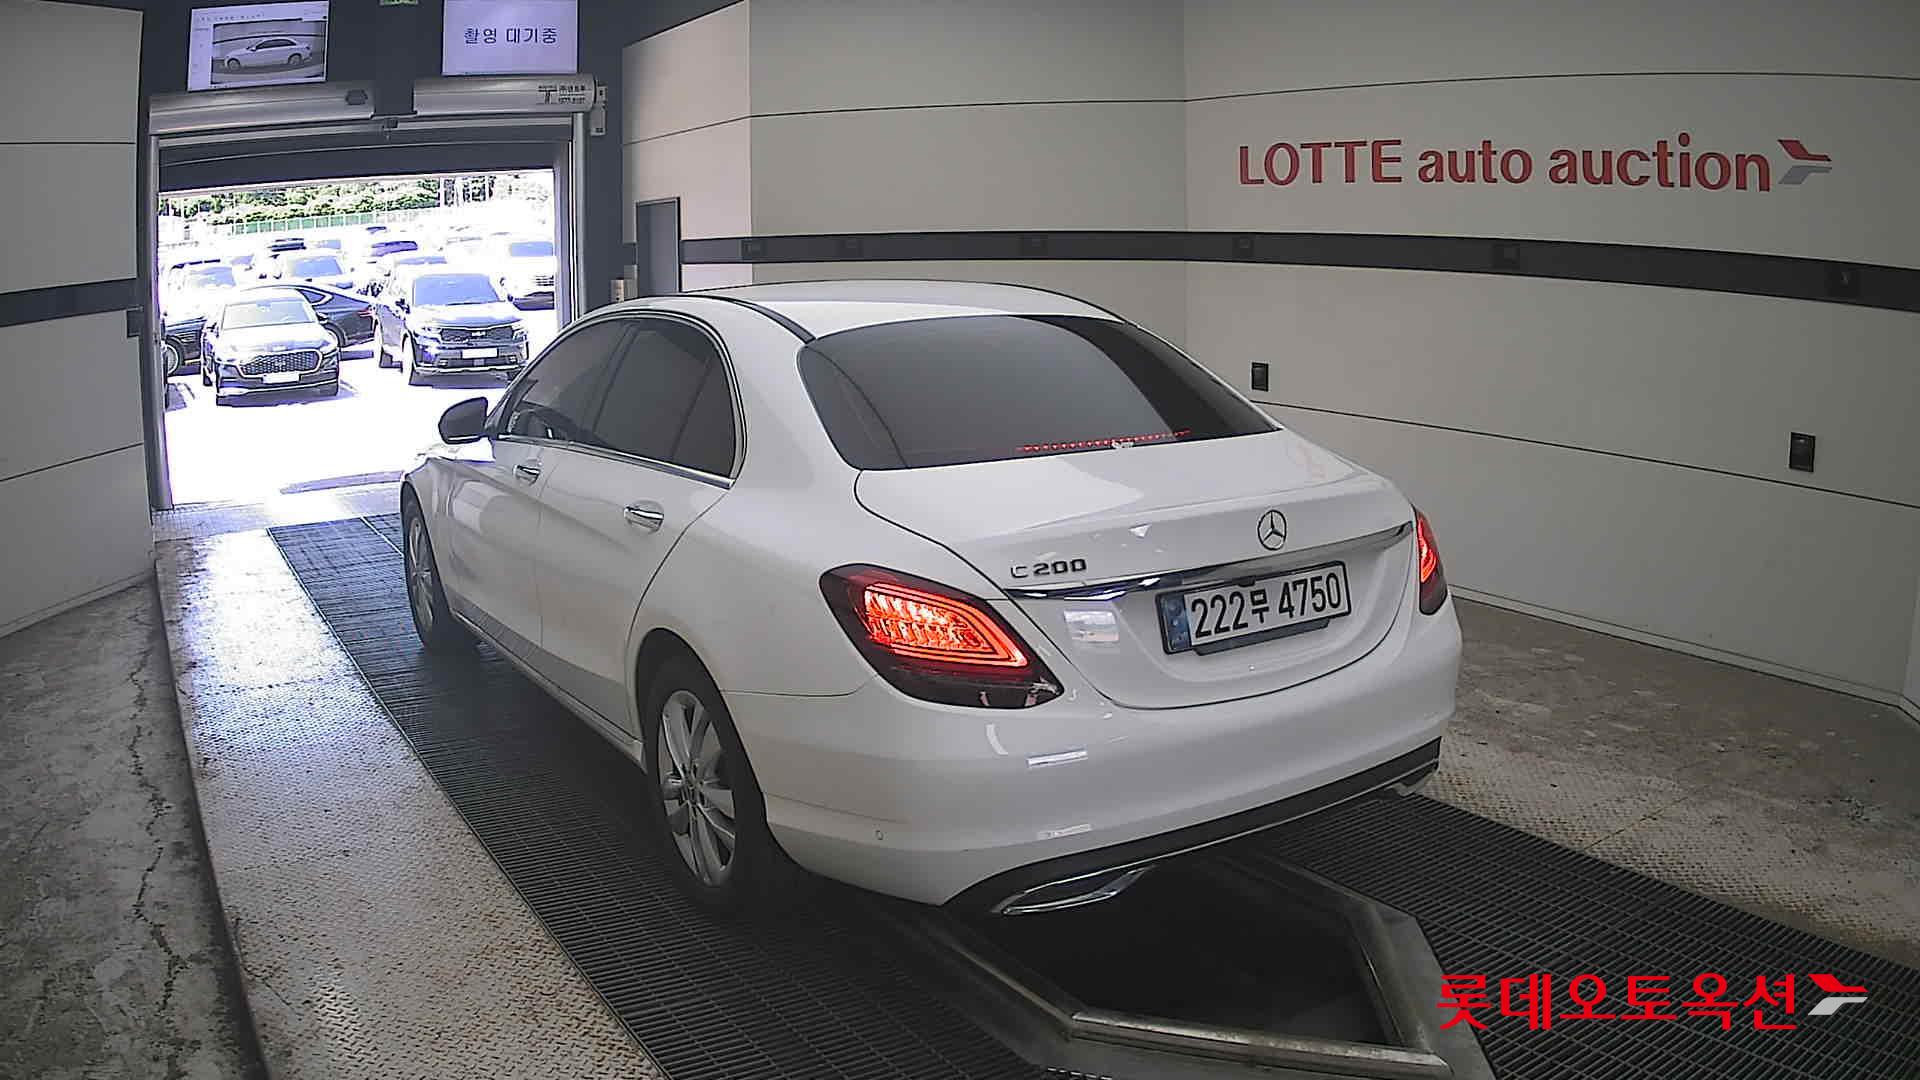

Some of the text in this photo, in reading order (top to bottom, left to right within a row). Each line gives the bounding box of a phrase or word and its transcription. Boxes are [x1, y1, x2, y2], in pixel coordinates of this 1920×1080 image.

[463, 27, 559, 44] 촬영 대기중
[1239, 132, 1772, 192] LOTTE auto auction
[1010, 558, 1087, 579] C 200
[1191, 572, 1343, 639] 222무 4750
